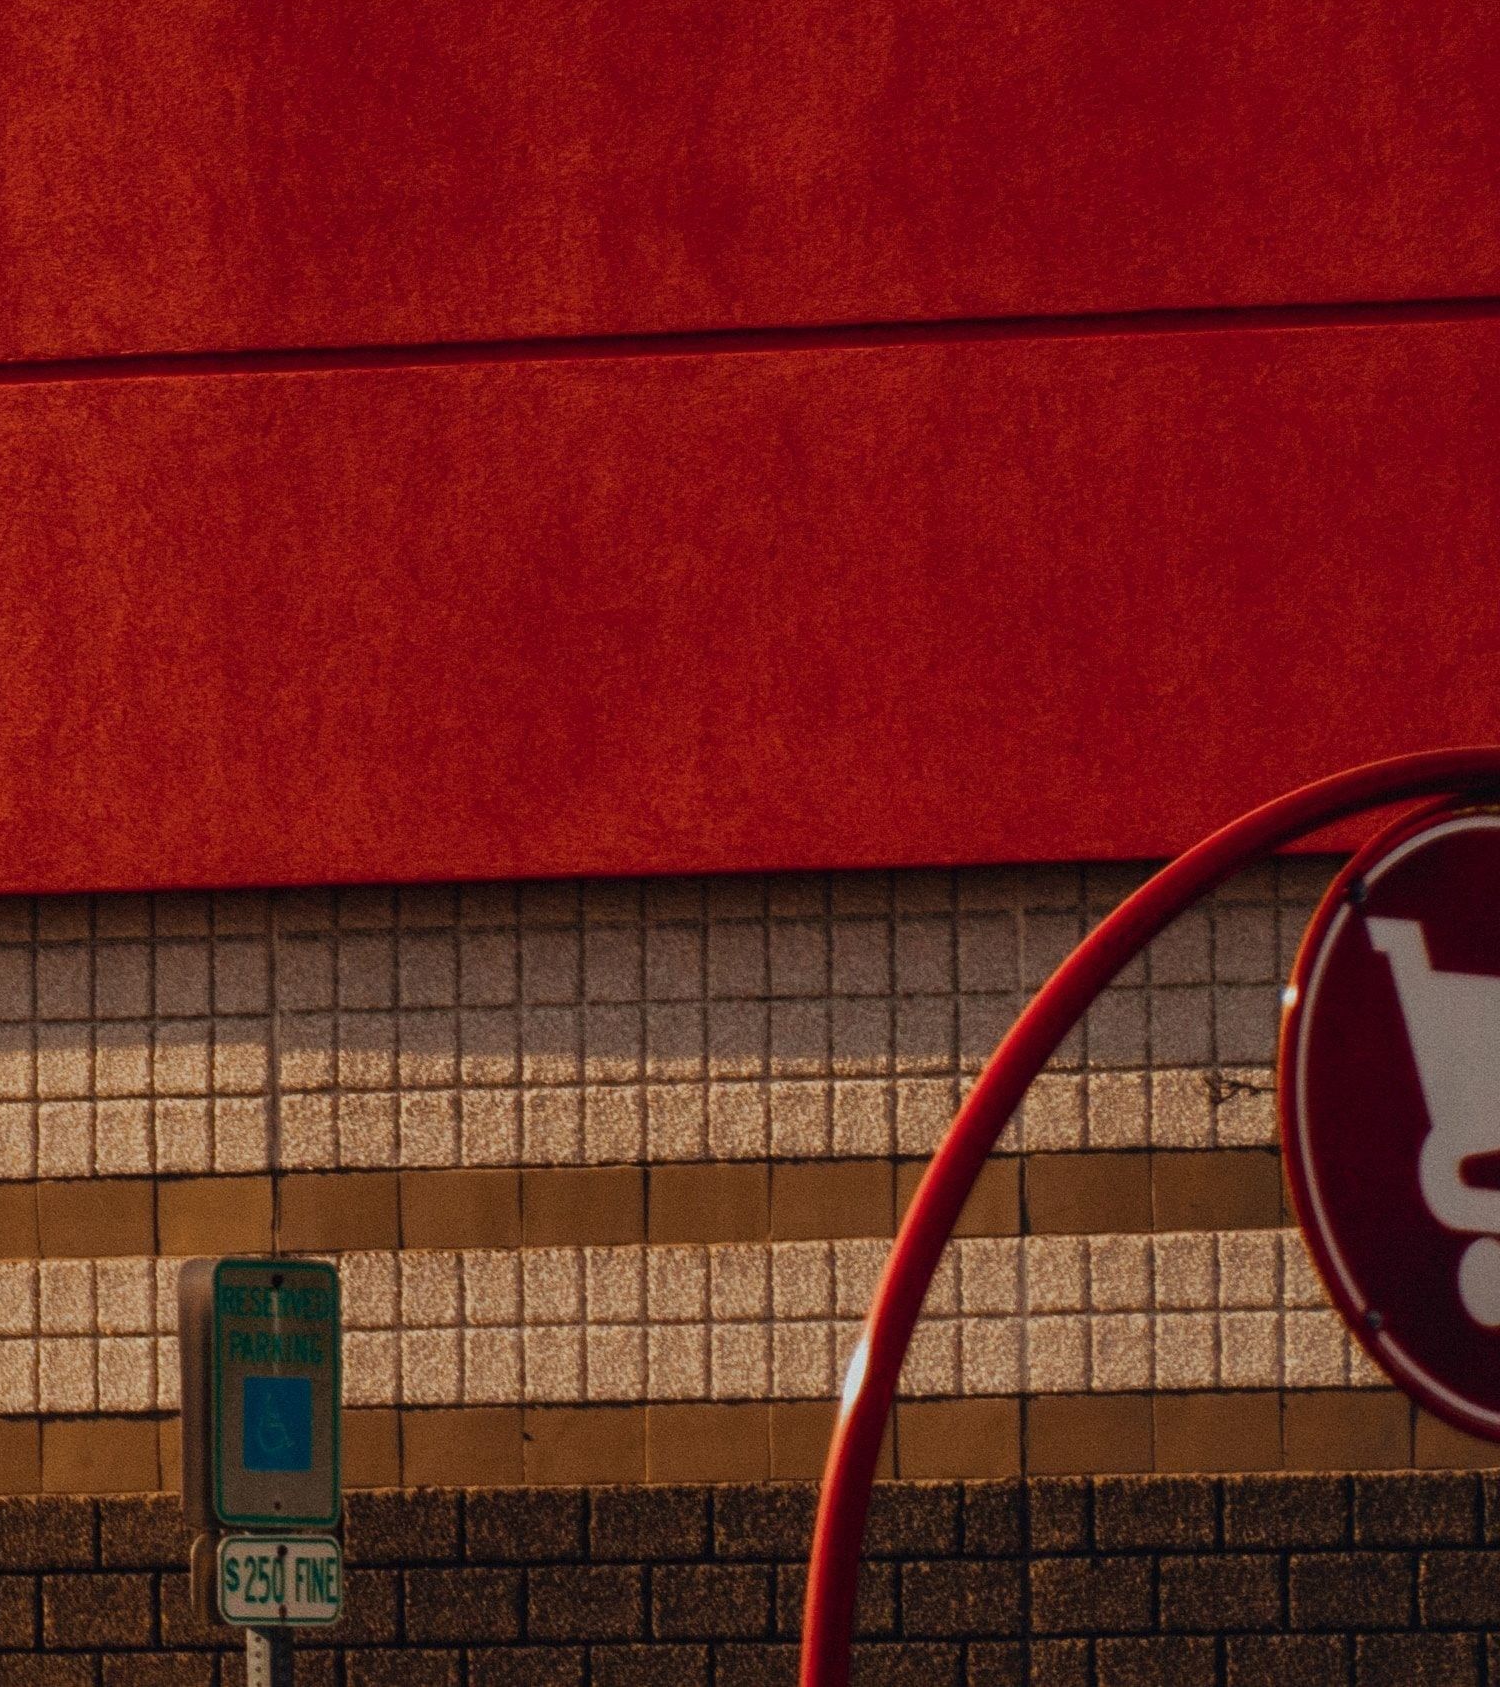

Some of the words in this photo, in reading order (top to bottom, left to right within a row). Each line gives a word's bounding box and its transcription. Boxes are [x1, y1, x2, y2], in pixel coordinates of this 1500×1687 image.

[220, 1285, 332, 1320] RESERVED
[228, 1330, 324, 1365] PARKING
[295, 1556, 341, 1605] FINE
